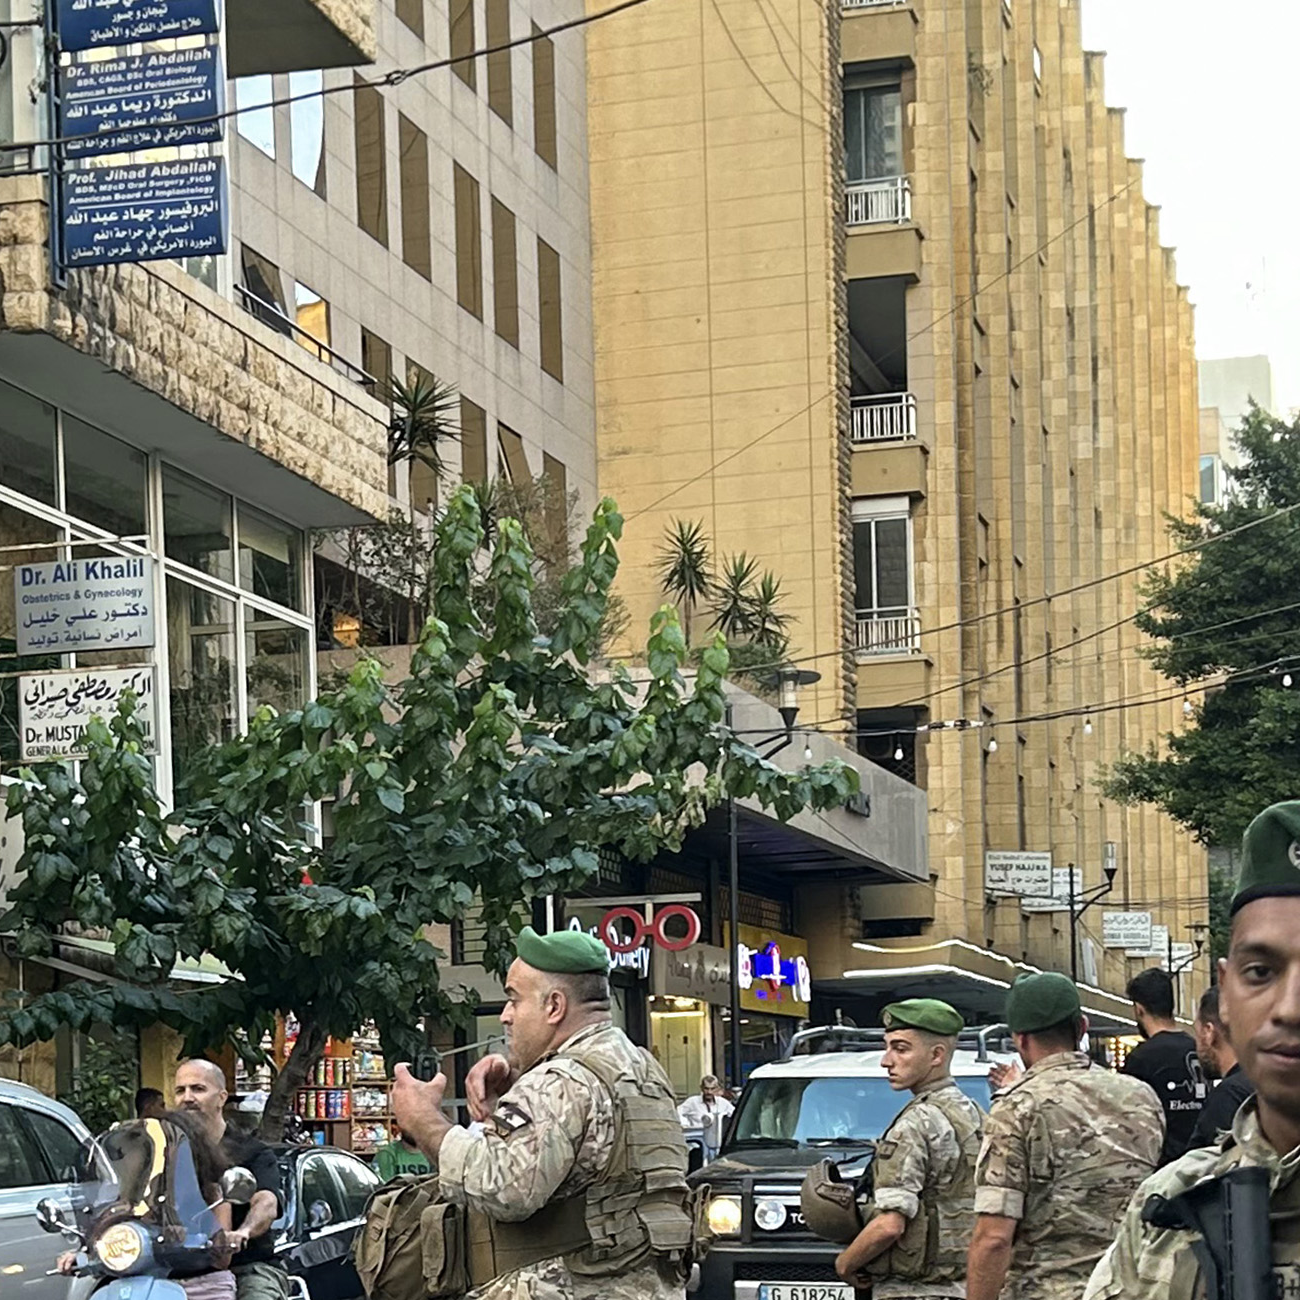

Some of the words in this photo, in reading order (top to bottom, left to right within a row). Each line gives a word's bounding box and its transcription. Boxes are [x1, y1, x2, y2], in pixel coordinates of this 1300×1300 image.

[67, 66, 86, 78] Dr.
[90, 61, 127, 75] Rima
[131, 57, 144, 69] J.
[148, 48, 212, 67] Abdallah
[145, 68, 164, 78] Oral
[165, 65, 197, 76] Biology
[66, 88, 106, 100] American
[107, 84, 132, 95] Board
[134, 82, 143, 92] of
[144, 75, 208, 91] Periodontology
[121, 99, 151, 114] ريما
[153, 89, 212, 110] الدكتورة
[66, 105, 88, 118] الله
[91, 103, 118, 117] عبد
[153, 132, 162, 143] في
[68, 173, 96, 185] Prof.
[105, 167, 146, 182] Jihad
[150, 161, 216, 177] Abdallah
[127, 181, 147, 189] Oral
[148, 178, 184, 188] Surgery
[69, 195, 112, 204] American
[114, 192, 141, 200] Board
[143, 190, 153, 198] of
[155, 186, 215, 198] Implantology
[66, 211, 88, 225] الله
[122, 207, 155, 222] جهاد
[158, 200, 219, 221] البروفيسور
[91, 212, 118, 225] عبد
[93, 230, 113, 243] الفم
[146, 228, 156, 240] في
[136, 241, 149, 256] في
[190, 236, 217, 249] البورد
[21, 567, 46, 586] Dr.
[52, 563, 78, 583] Ali
[85, 558, 144, 580] Khalil
[22, 591, 71, 604] Obstetrics
[73, 590, 81, 599] &
[84, 587, 144, 600] Gynecology
[26, 727, 44, 743] Dr.
[45, 724, 88, 742] MUSTA
[26, 744, 61, 757] GENERAL
